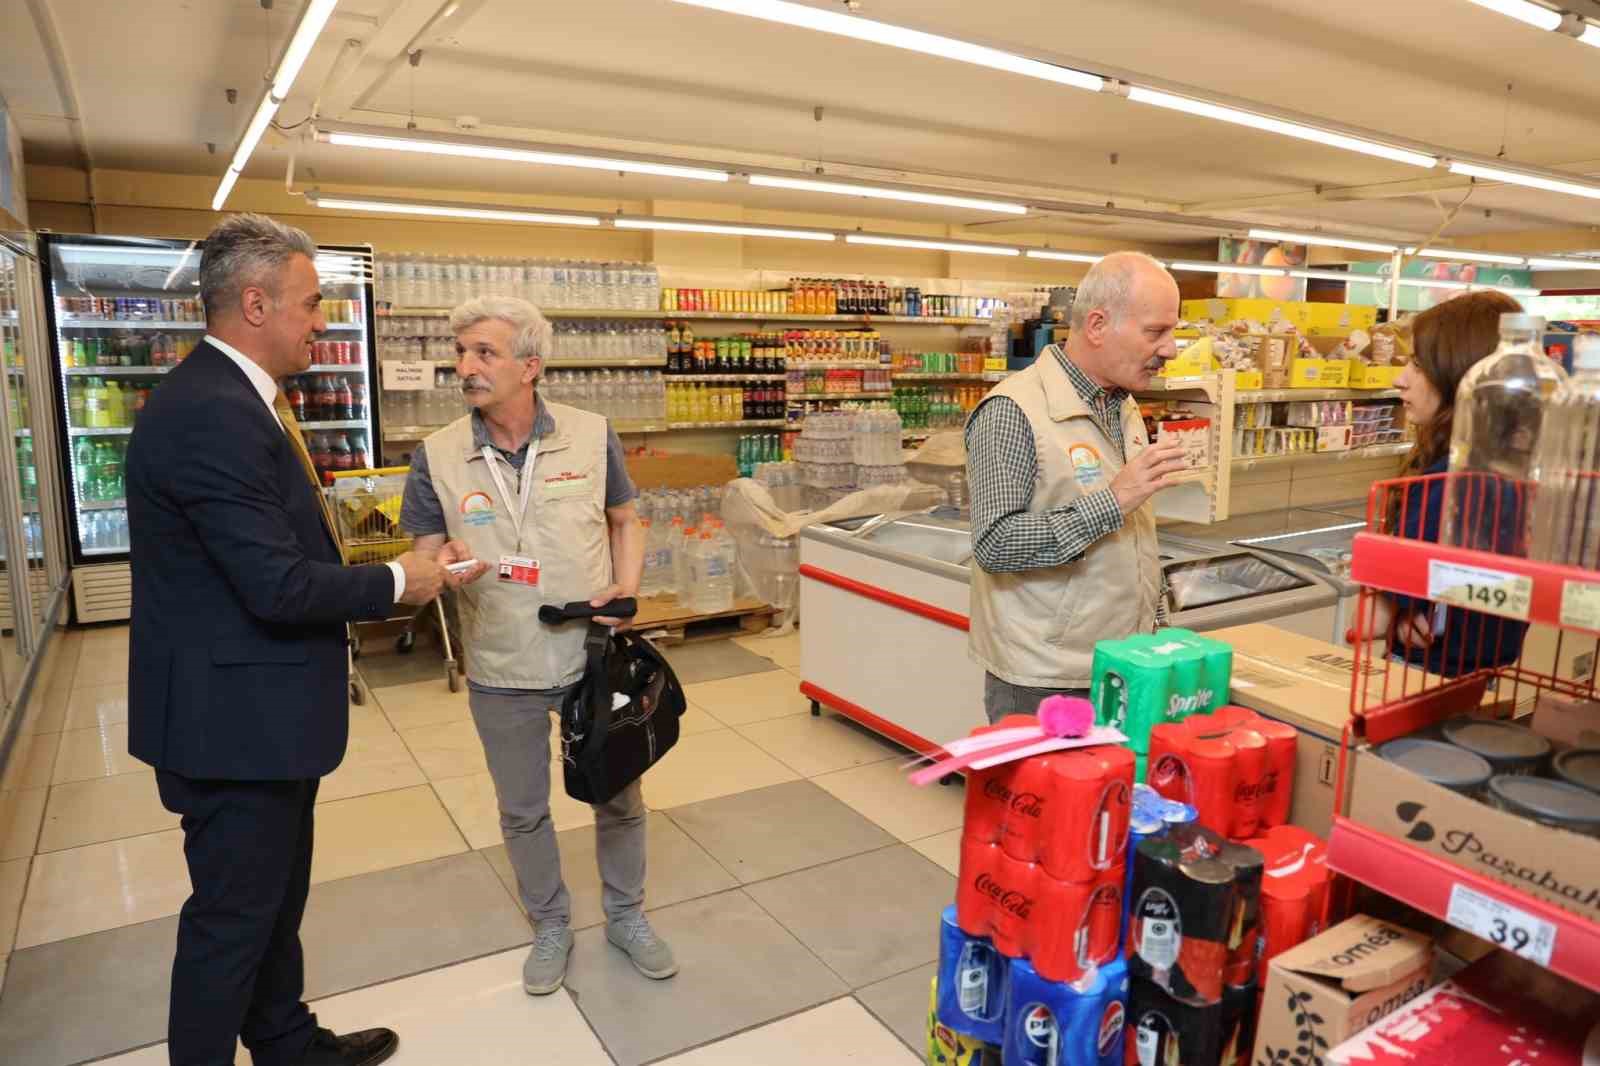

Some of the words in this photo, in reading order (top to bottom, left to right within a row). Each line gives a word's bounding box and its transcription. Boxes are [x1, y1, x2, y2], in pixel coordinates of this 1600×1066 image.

[1465, 583, 1508, 608] 149
[1166, 688, 1214, 718] Sprite
[975, 872, 1035, 919] Coca-Cola
[1488, 917, 1530, 952] 39
